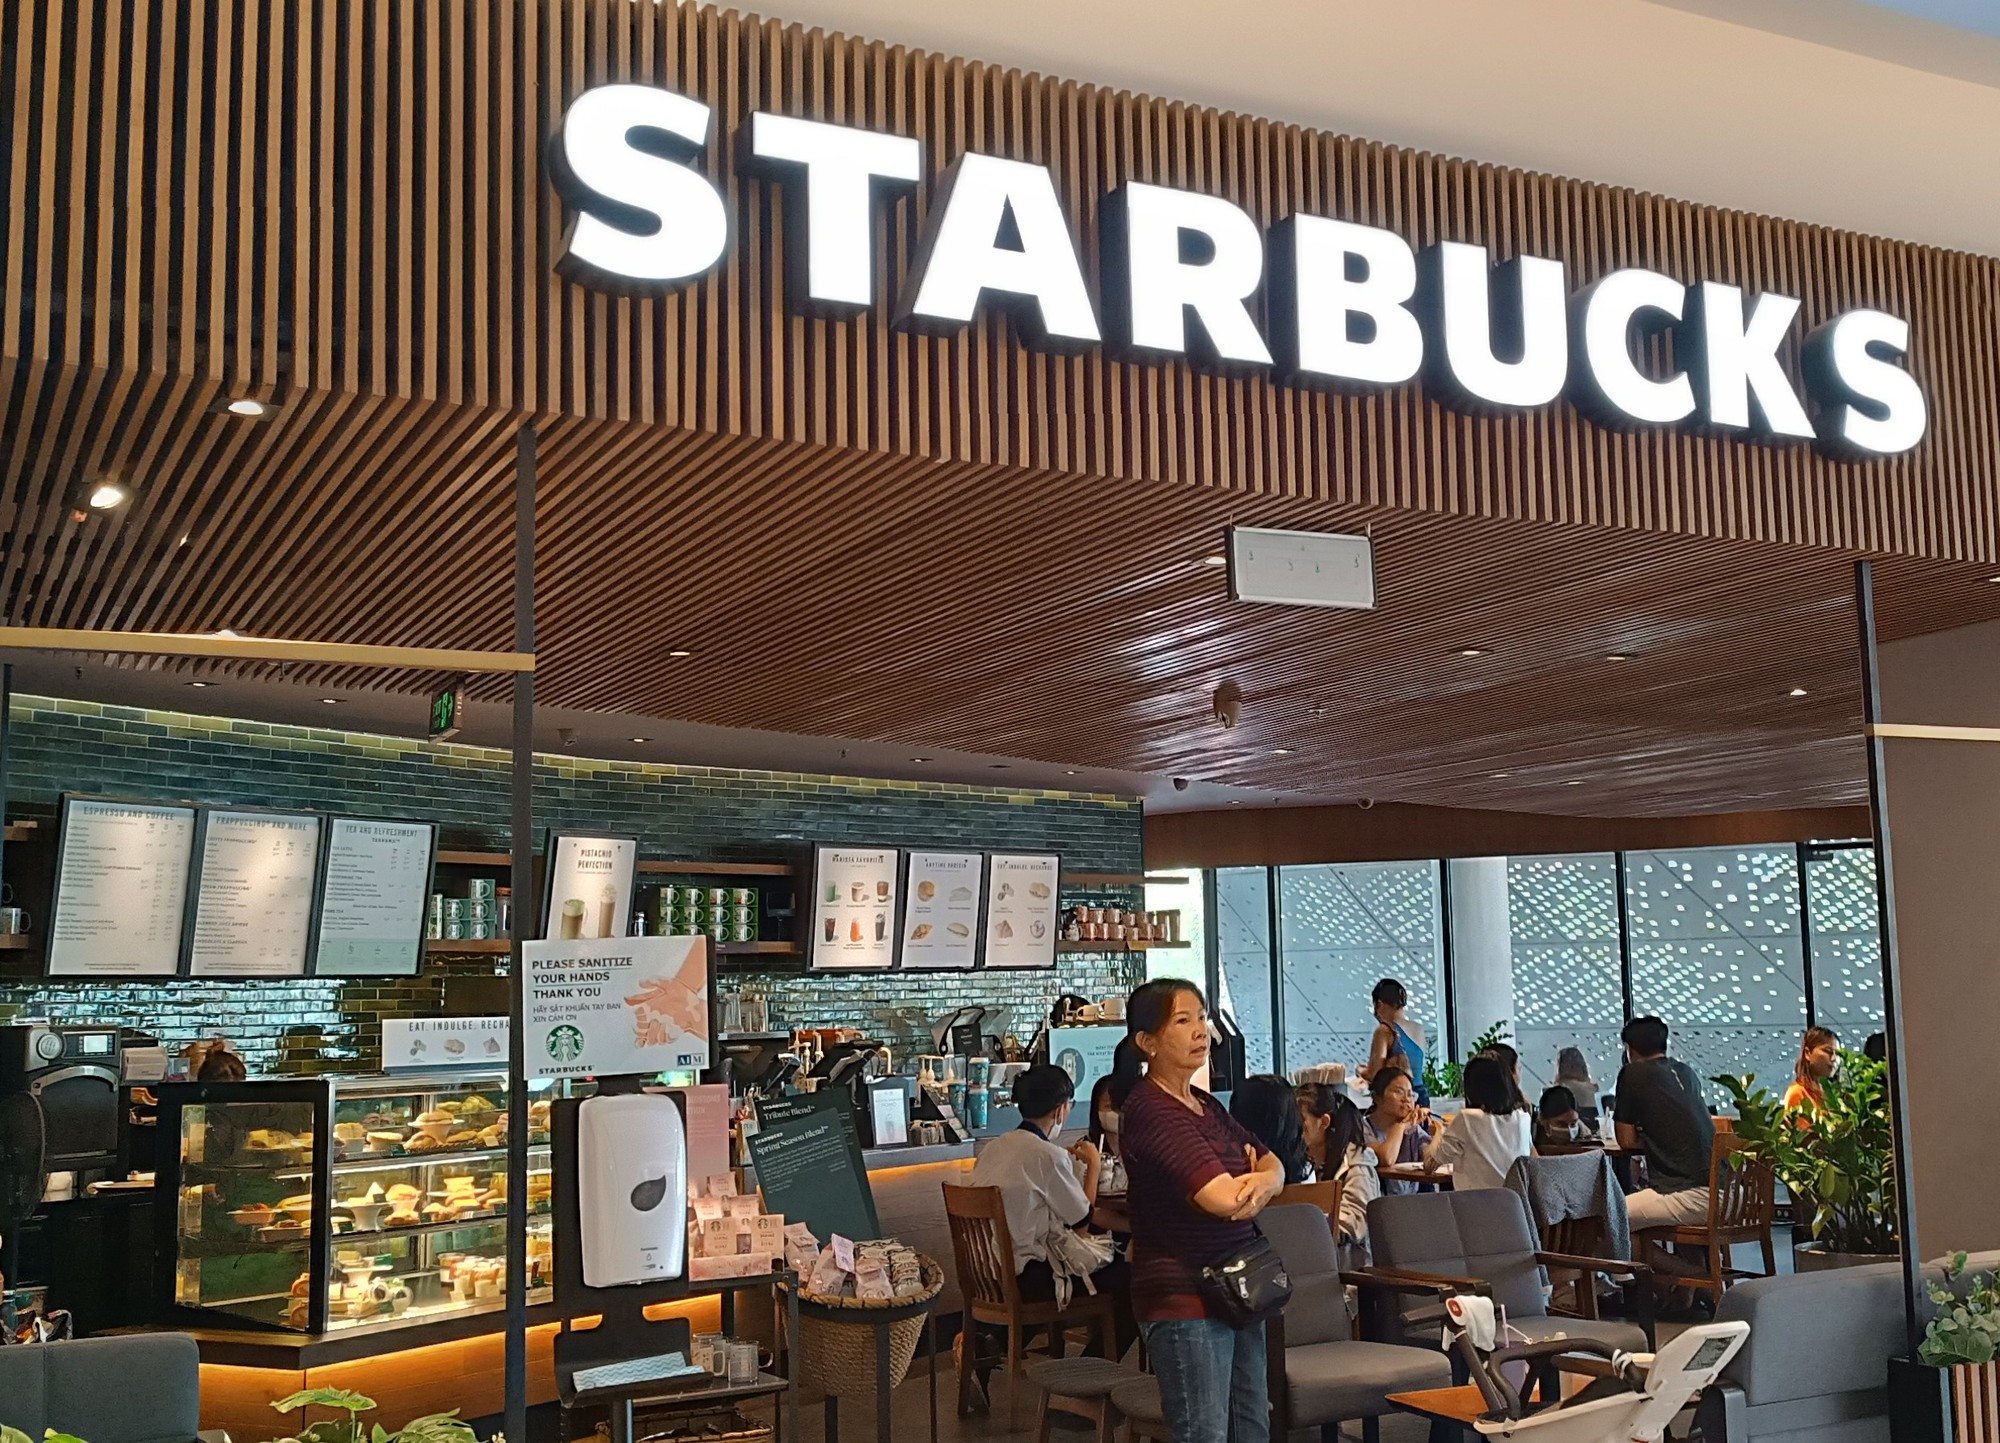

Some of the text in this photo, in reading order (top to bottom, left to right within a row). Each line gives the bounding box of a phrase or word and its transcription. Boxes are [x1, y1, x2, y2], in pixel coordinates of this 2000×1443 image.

[562, 82, 1927, 455] STARBUCKS
[532, 957, 633, 970] PLEASE SANITIZE
[533, 971, 610, 984] YOUR HANDS
[533, 987, 601, 999] THANK YOU
[538, 1065, 593, 1075] STARBUCKS
[763, 1110, 791, 1120] Tribute
[756, 1143, 781, 1155] Spring
[780, 1133, 806, 1147] Season
